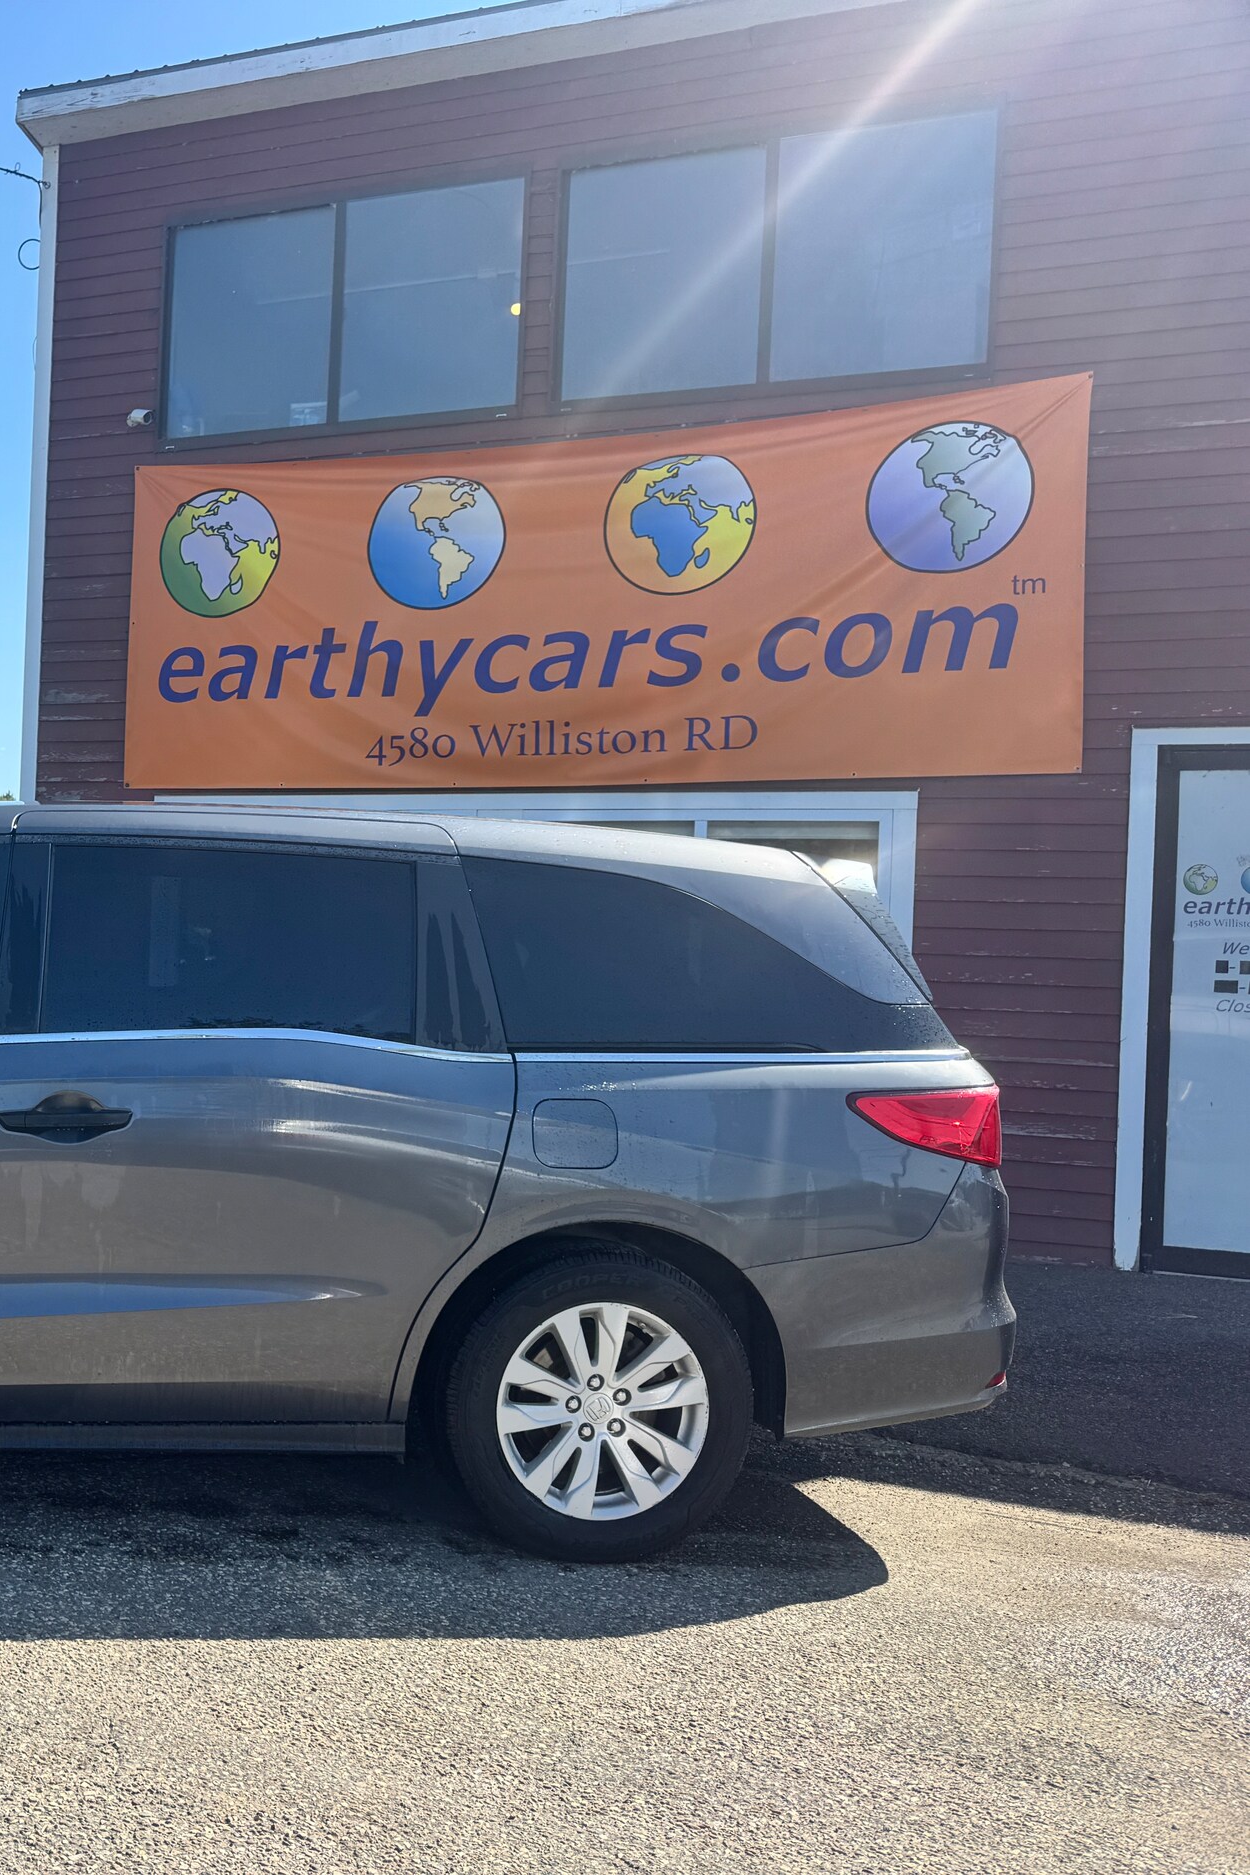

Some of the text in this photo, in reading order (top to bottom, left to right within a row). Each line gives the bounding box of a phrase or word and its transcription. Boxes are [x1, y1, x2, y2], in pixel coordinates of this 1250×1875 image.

[1011, 574, 1047, 596] tm
[158, 603, 1019, 717] earthycars.com
[365, 714, 759, 767] 4580 Williston RD
[1187, 918, 1211, 928] 4580
